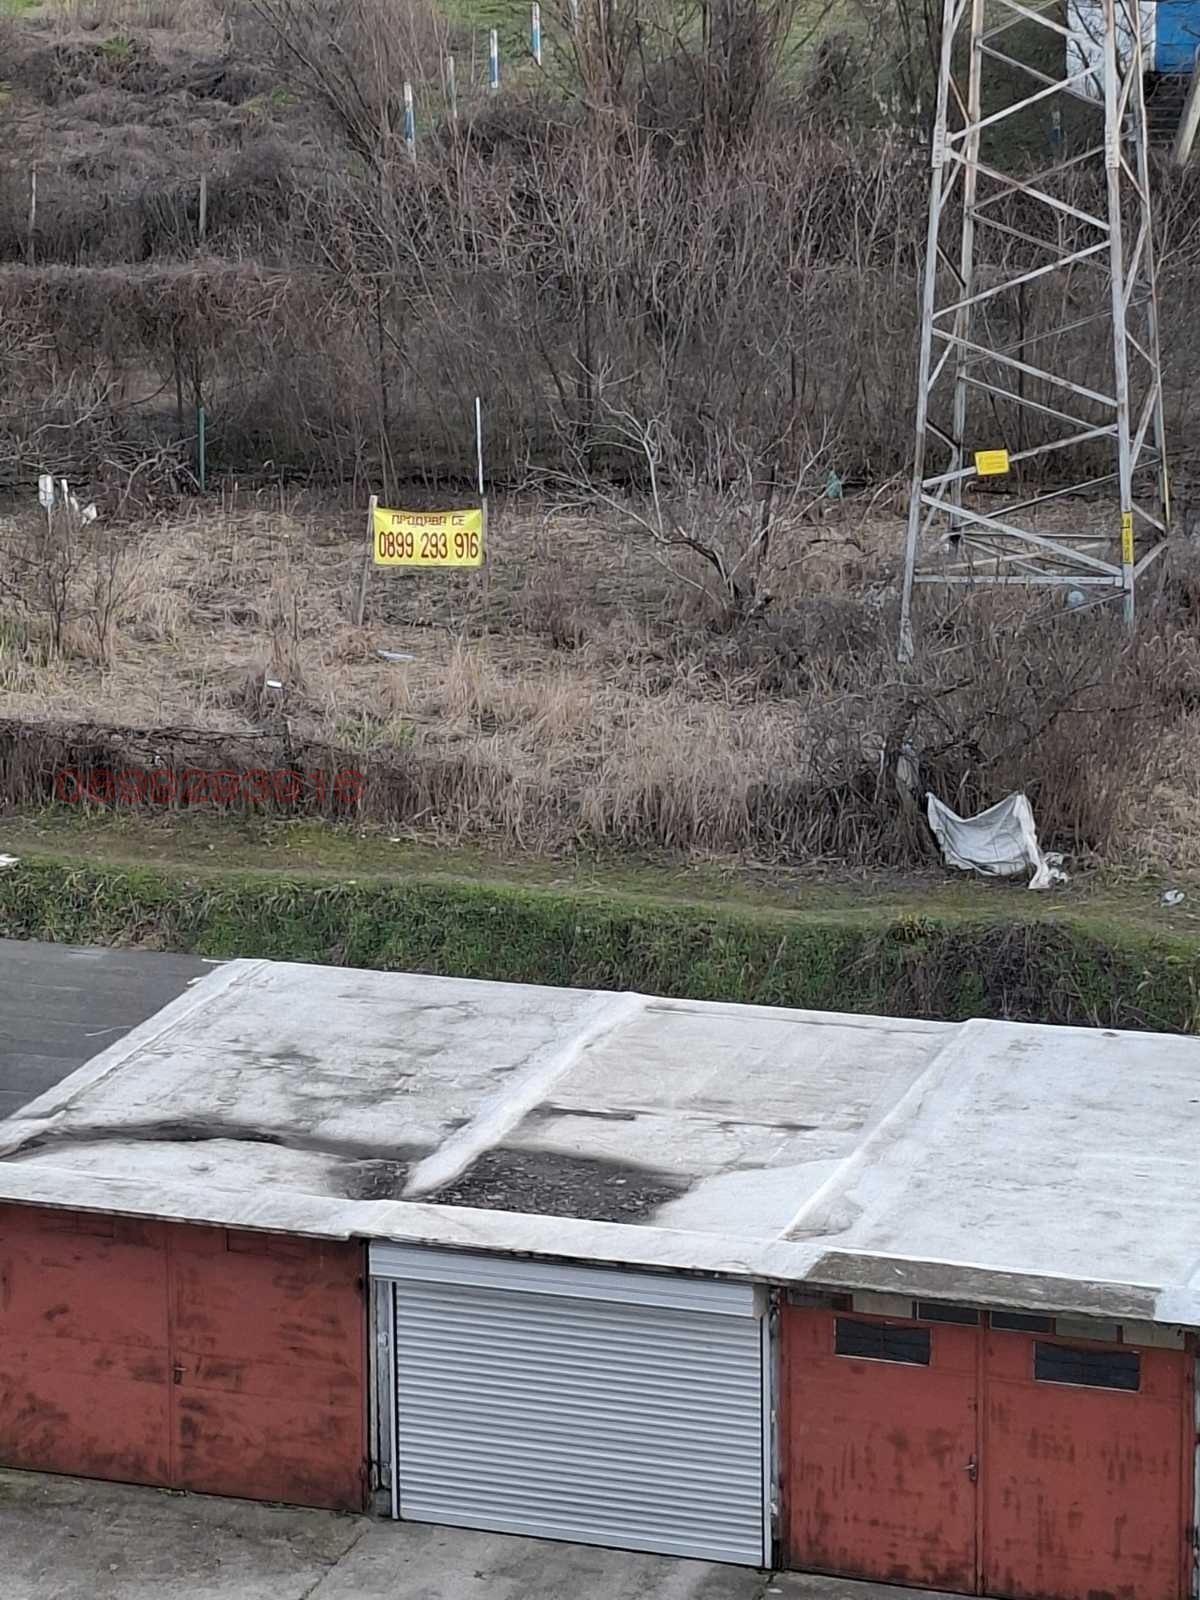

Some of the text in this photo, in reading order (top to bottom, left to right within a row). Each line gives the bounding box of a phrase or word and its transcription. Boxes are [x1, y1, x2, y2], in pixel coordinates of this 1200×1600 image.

[379, 531, 479, 559] 0899 293 916
